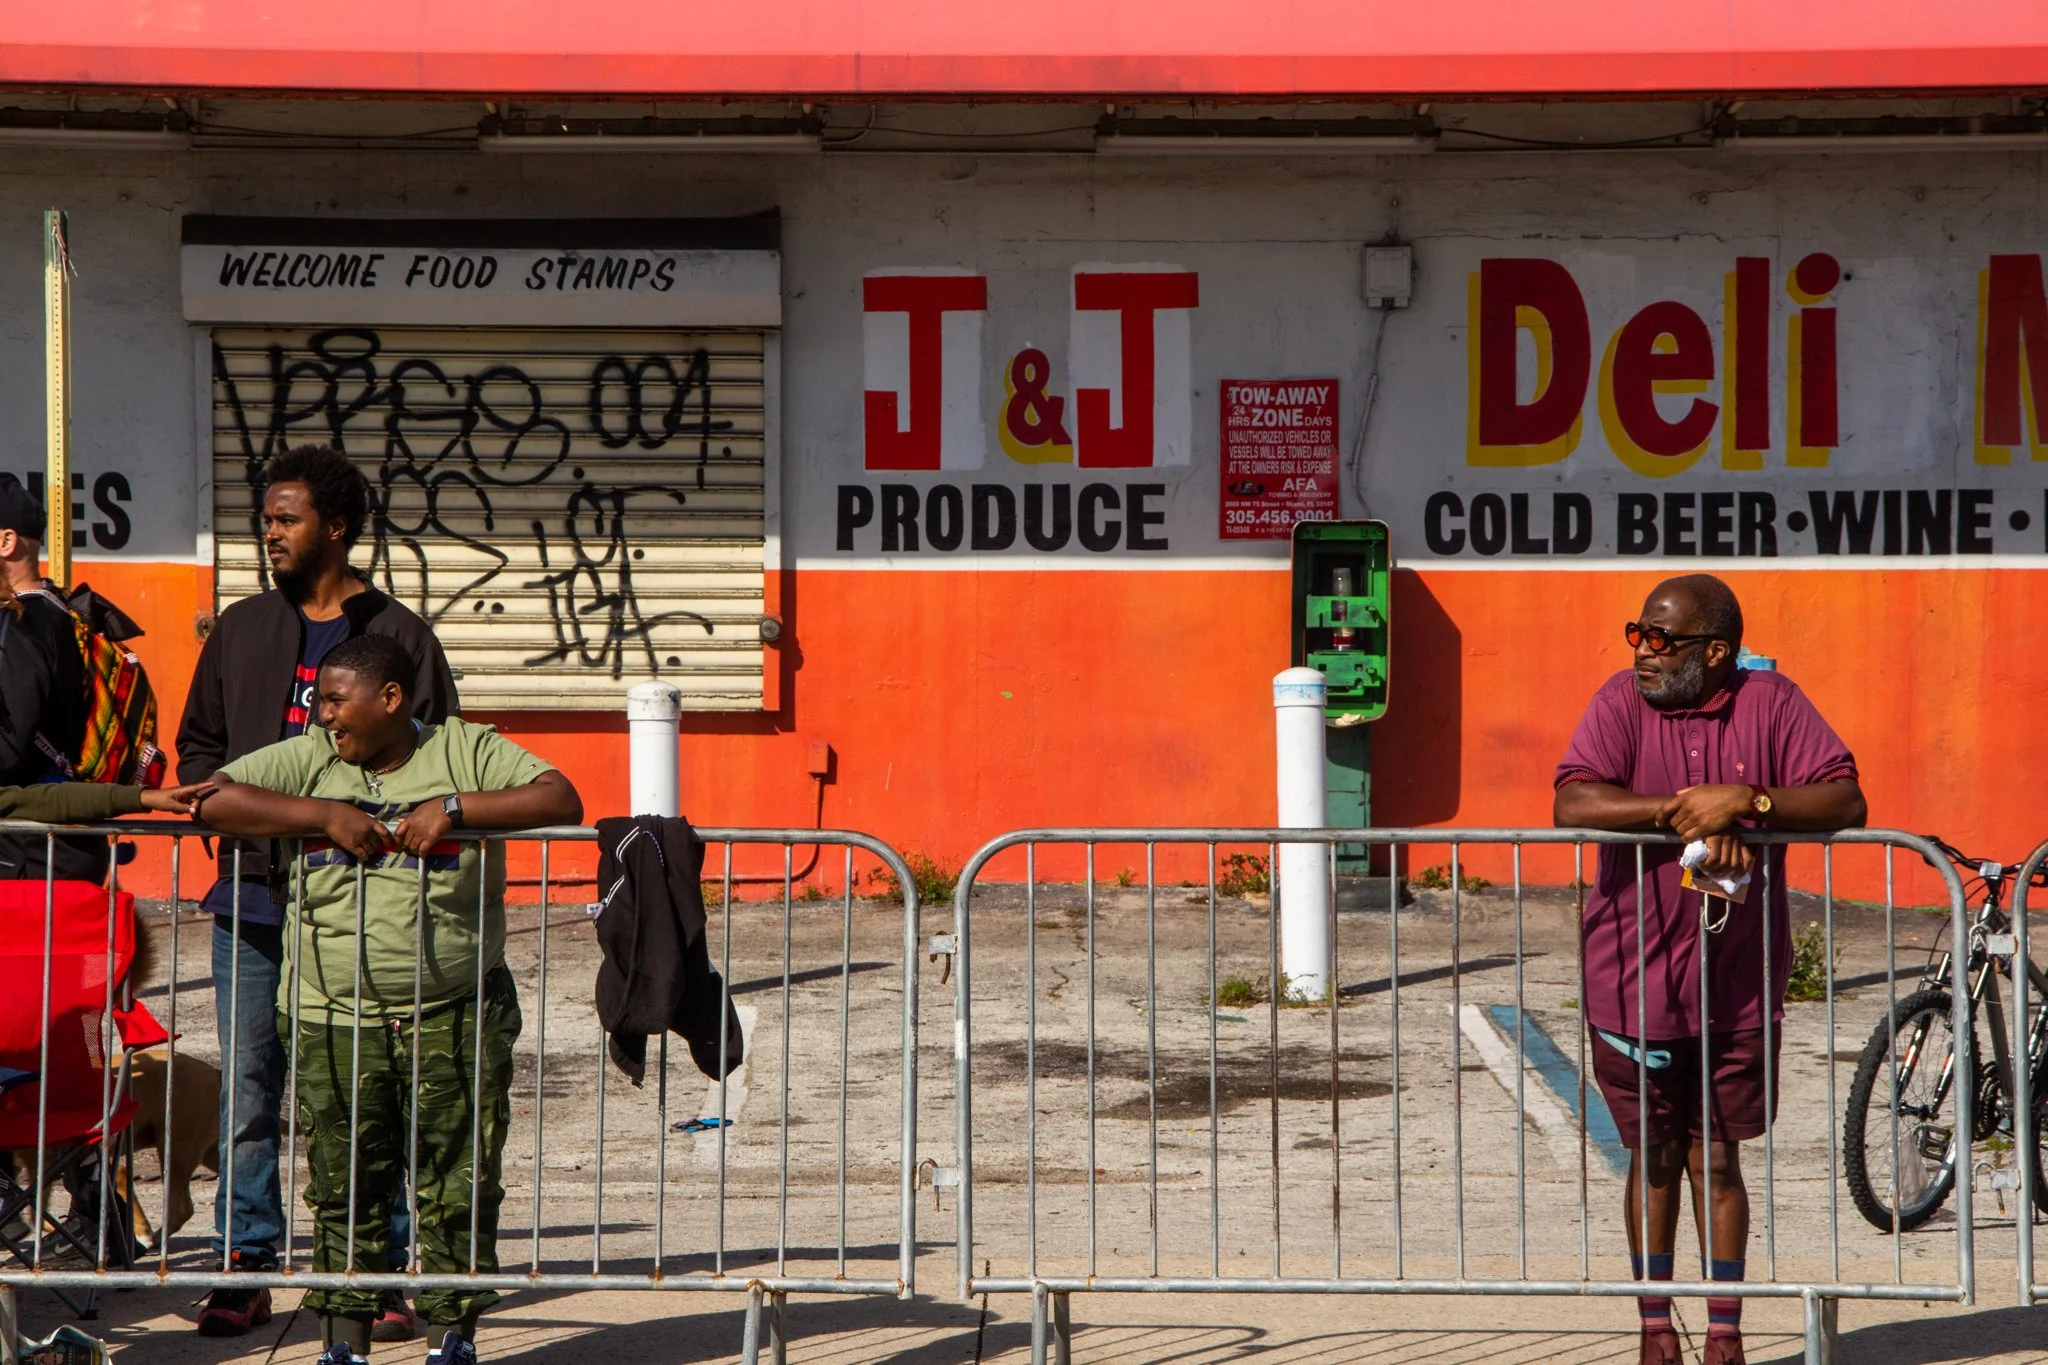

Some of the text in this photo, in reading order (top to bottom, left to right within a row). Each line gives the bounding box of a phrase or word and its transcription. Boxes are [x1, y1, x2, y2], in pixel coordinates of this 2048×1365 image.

[219, 252, 676, 292] WELCOME FOOD STAMPS
[863, 272, 1199, 471] J & J
[1466, 252, 1841, 478] Deli
[1227, 386, 1330, 405] TOW-AWAY
[1233, 406, 1246, 416] 24
[1252, 408, 1304, 427] ZONE
[1315, 406, 1322, 415] 7
[1228, 416, 1250, 426] HRS
[1304, 416, 1333, 426] DAYS
[1228, 430, 1332, 443] UNAUTHORIZED VEHICLES OR
[1229, 445, 1331, 458] VESSELS WILL BE TOWED AWAY
[1229, 460, 1332, 474] AT THE OWNERS RISK & EXPENSE
[1283, 478, 1317, 491] AFA
[836, 483, 1169, 552] PRODUCE
[1226, 510, 1333, 524] 305.456.9001
[1424, 491, 1593, 556] COLD
[1617, 491, 1778, 556] BEER
[1807, 489, 1993, 556] WINE
